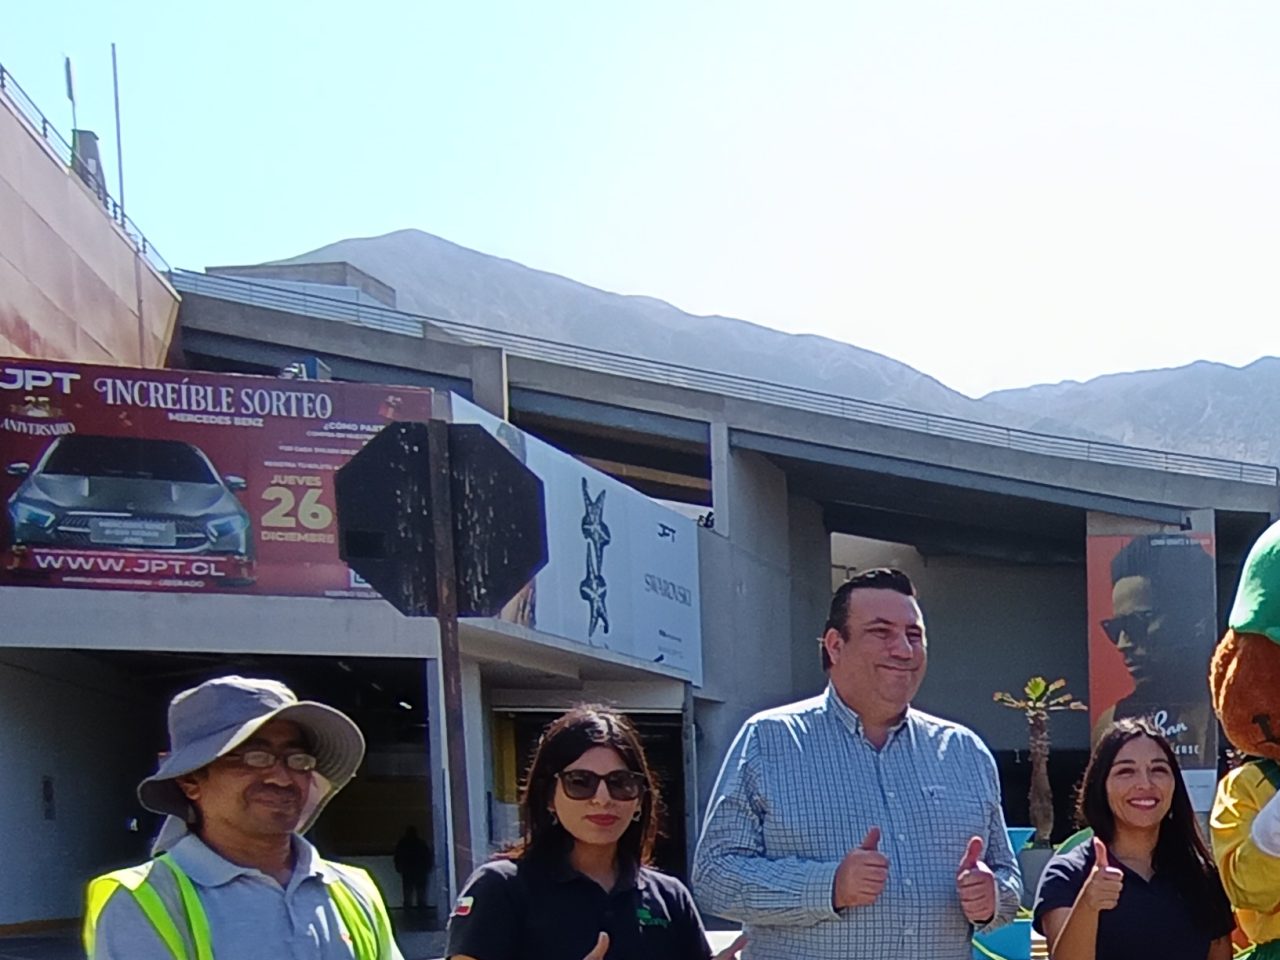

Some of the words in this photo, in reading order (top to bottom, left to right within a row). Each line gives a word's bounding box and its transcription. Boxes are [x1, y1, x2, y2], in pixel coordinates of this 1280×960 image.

[0, 368, 81, 394] JPT
[94, 377, 235, 413] INCREÍBLE
[240, 388, 333, 419] SORTEO
[270, 474, 322, 486] JUEVES
[261, 486, 333, 529] 26
[261, 531, 335, 543] DICIEMBRE
[35, 555, 226, 576] WWW.JPT.CL
